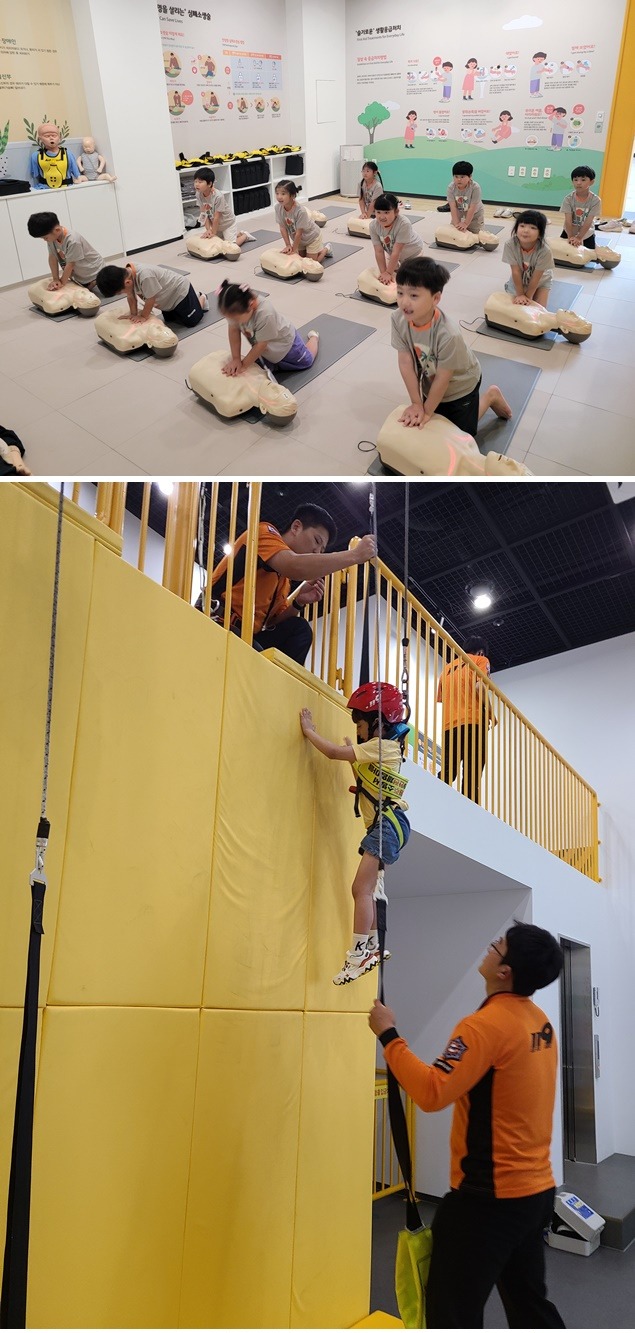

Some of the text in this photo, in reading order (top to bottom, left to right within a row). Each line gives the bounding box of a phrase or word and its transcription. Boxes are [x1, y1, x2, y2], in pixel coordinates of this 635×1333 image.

[188, 9, 211, 21] 심폐소생술
[375, 24, 402, 34] 생활응급처치
[530, 1021, 553, 1053] 119
